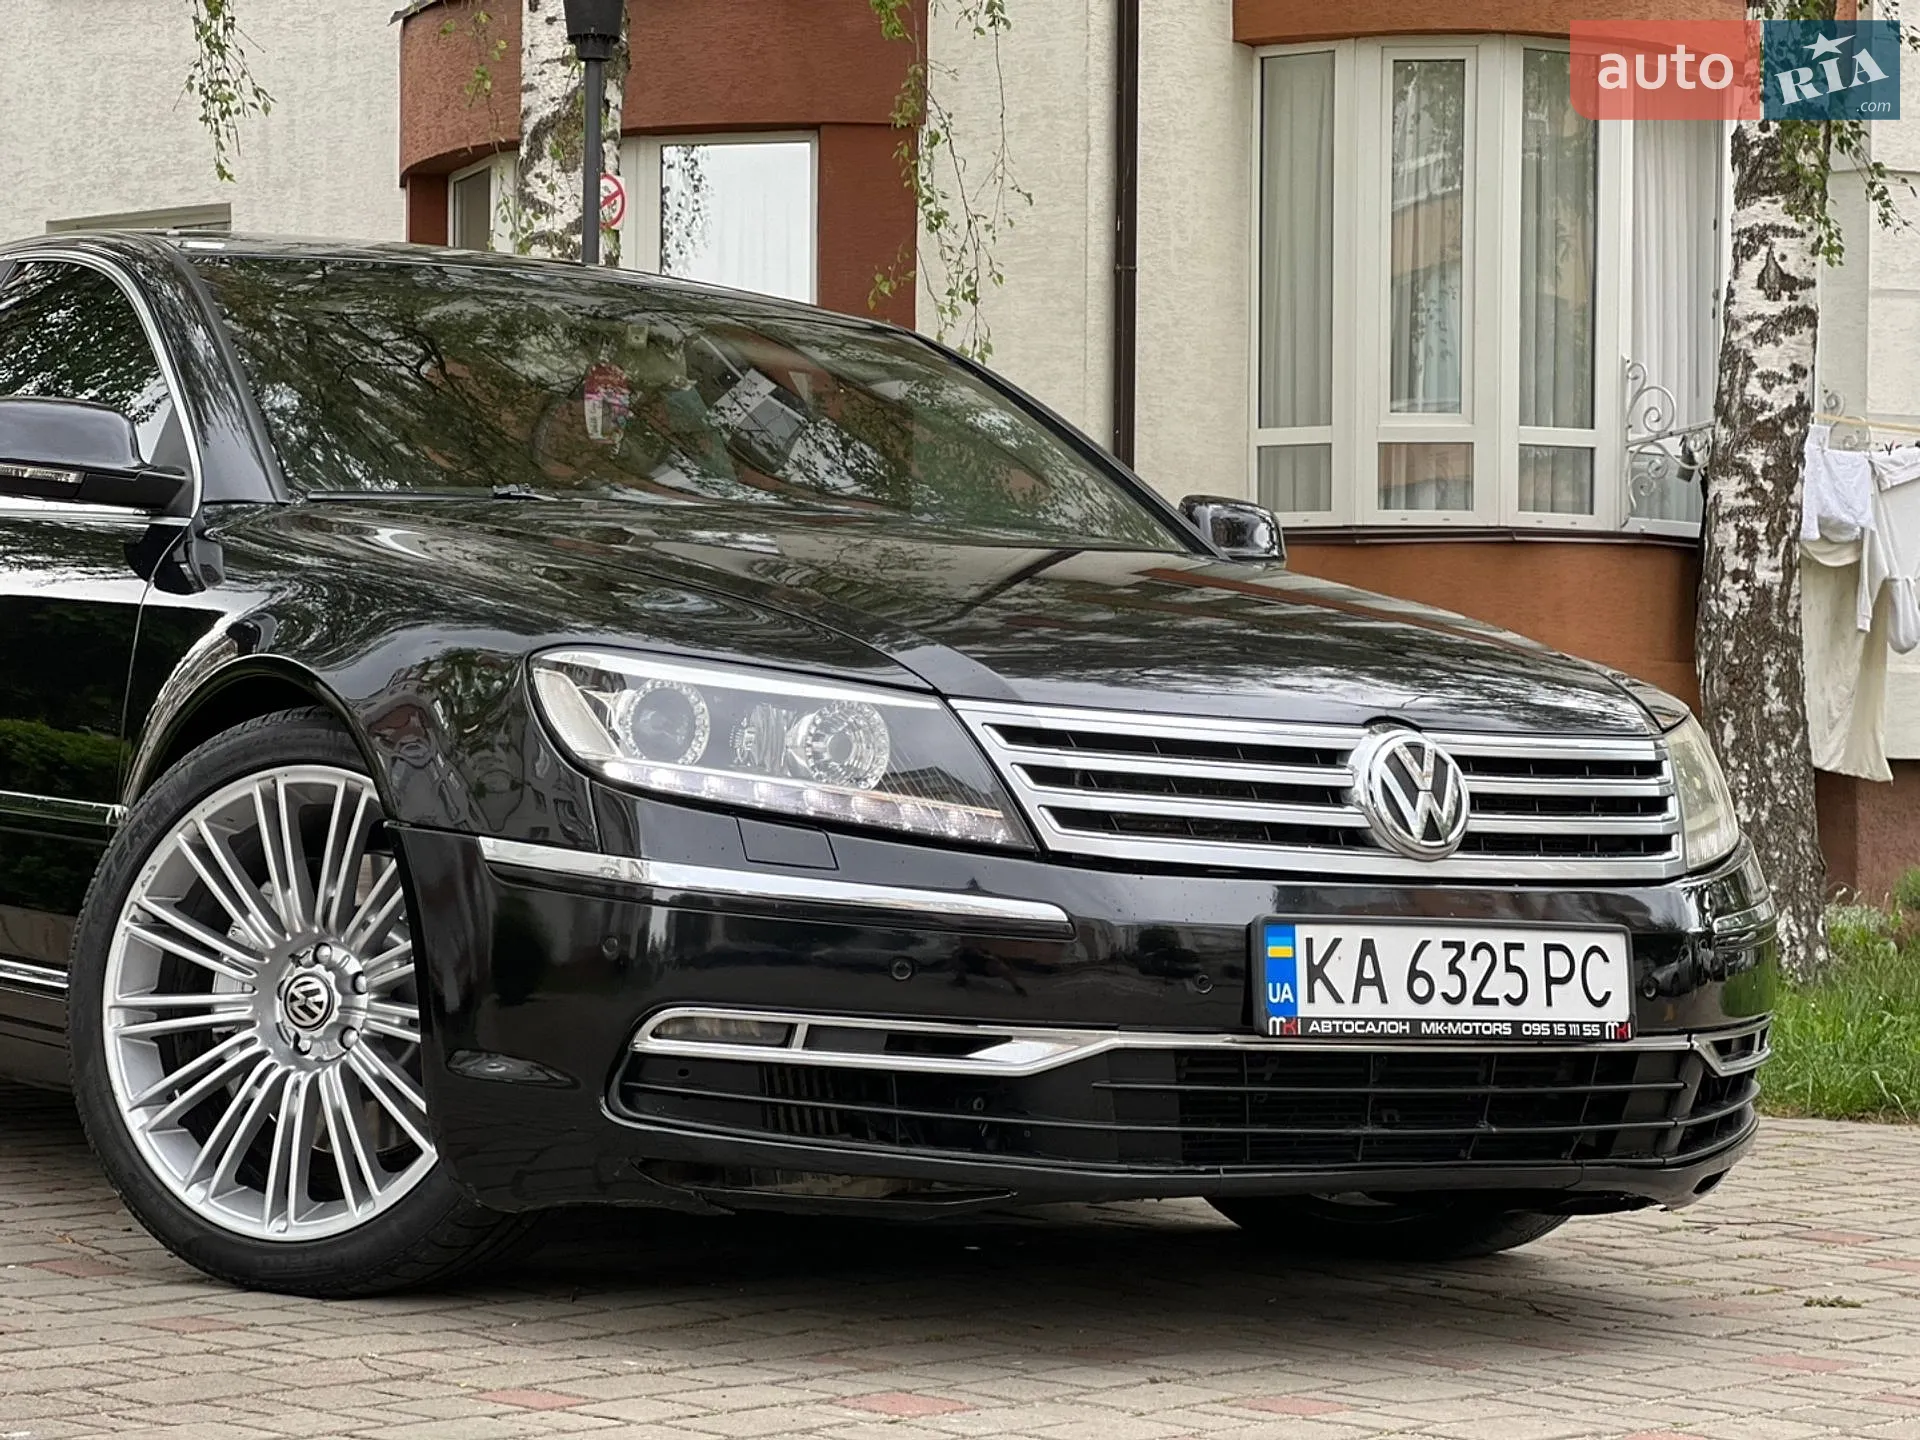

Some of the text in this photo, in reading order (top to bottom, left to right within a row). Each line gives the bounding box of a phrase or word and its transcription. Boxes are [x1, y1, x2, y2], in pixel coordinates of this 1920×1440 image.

[1304, 936, 1613, 1008] KA 6325 PC
[1267, 982, 1294, 1004] UA
[1308, 1019, 1411, 1035] АВТОСАЛОН
[1420, 1020, 1513, 1036] MK-MOTORS
[1521, 1022, 1551, 1036] 095
[1552, 1022, 1567, 1036] 15
[1582, 1023, 1602, 1037] 55
